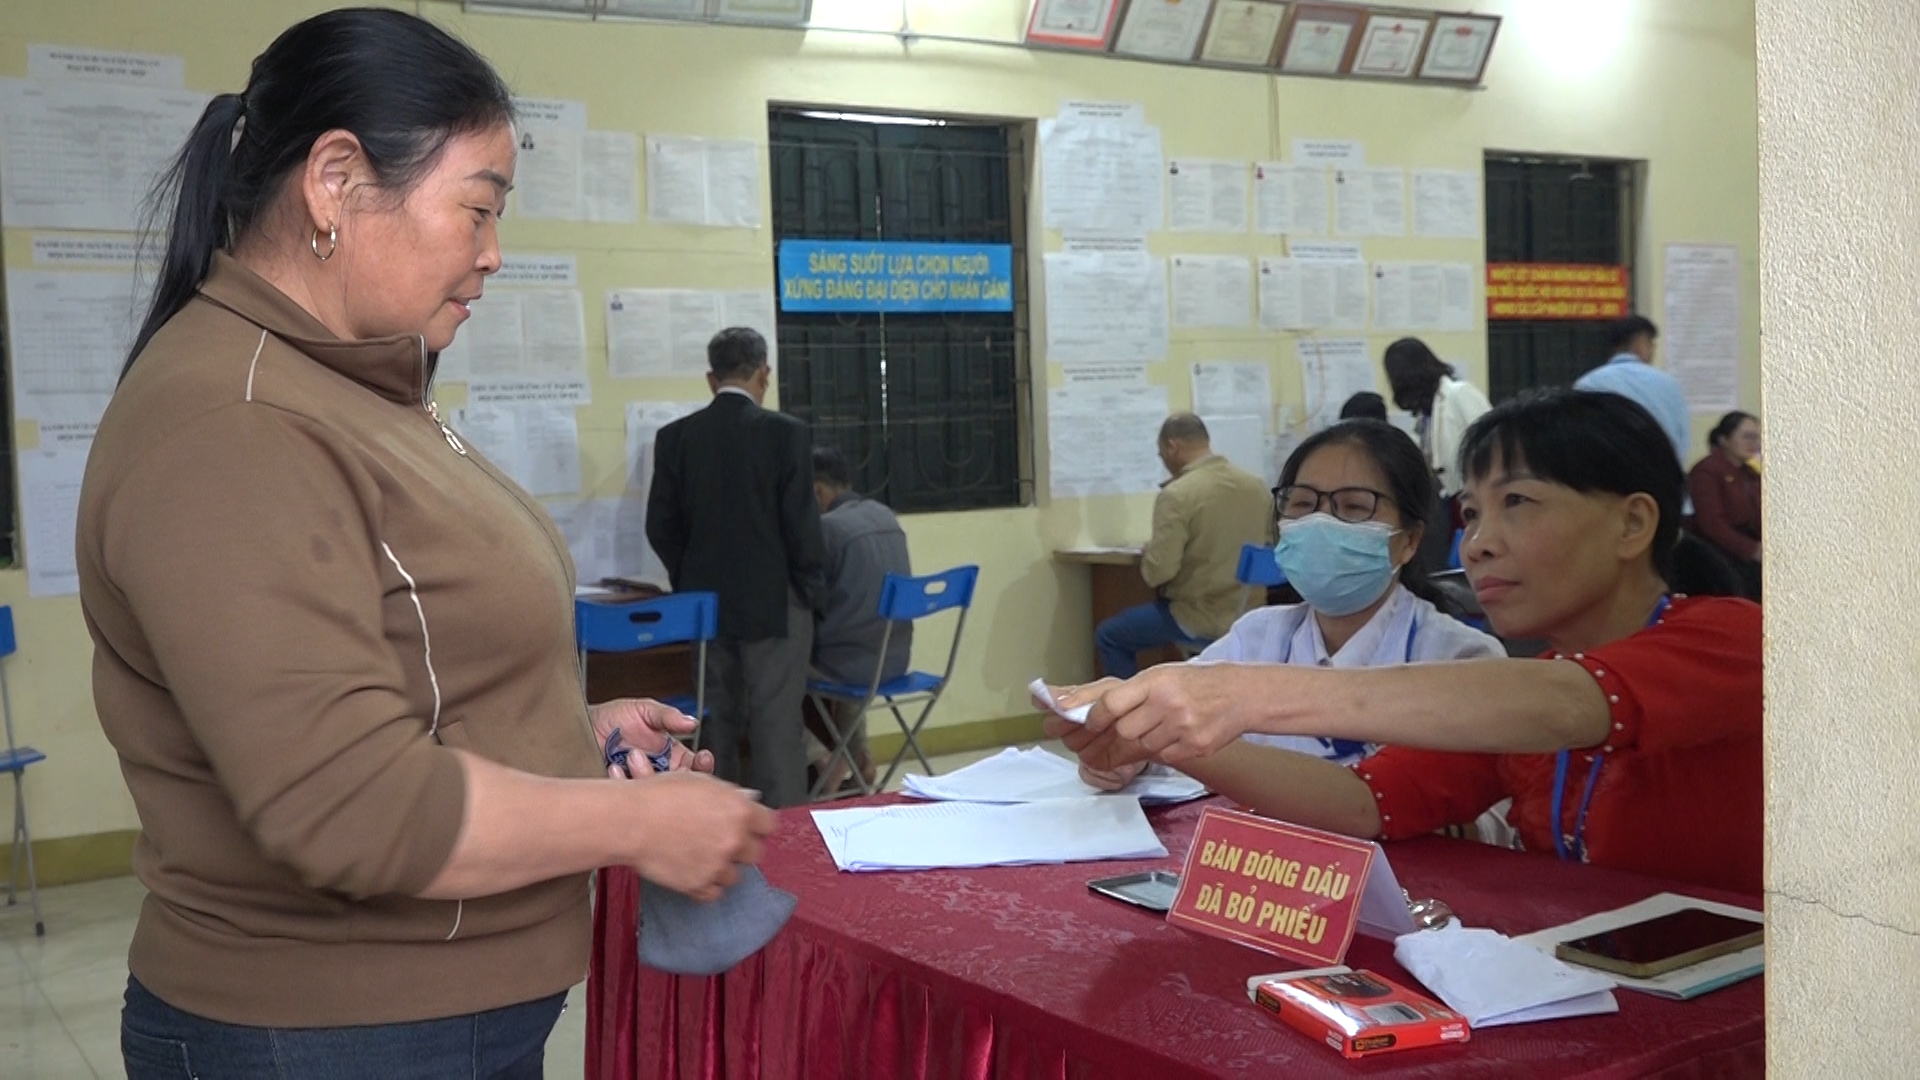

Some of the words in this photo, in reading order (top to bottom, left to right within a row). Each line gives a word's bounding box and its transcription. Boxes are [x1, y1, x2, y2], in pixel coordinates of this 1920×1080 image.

[809, 250, 847, 274] SÁNG
[850, 249, 885, 274] SUỐT
[888, 254, 914, 278] LỰA
[1199, 838, 1243, 873] BÀN
[1241, 849, 1301, 888] ĐÓNG
[1301, 861, 1351, 901] DẤU
[1195, 881, 1225, 916] ĐÃ
[1224, 885, 1257, 924] BỎ
[1256, 903, 1328, 945] PHIẾU
